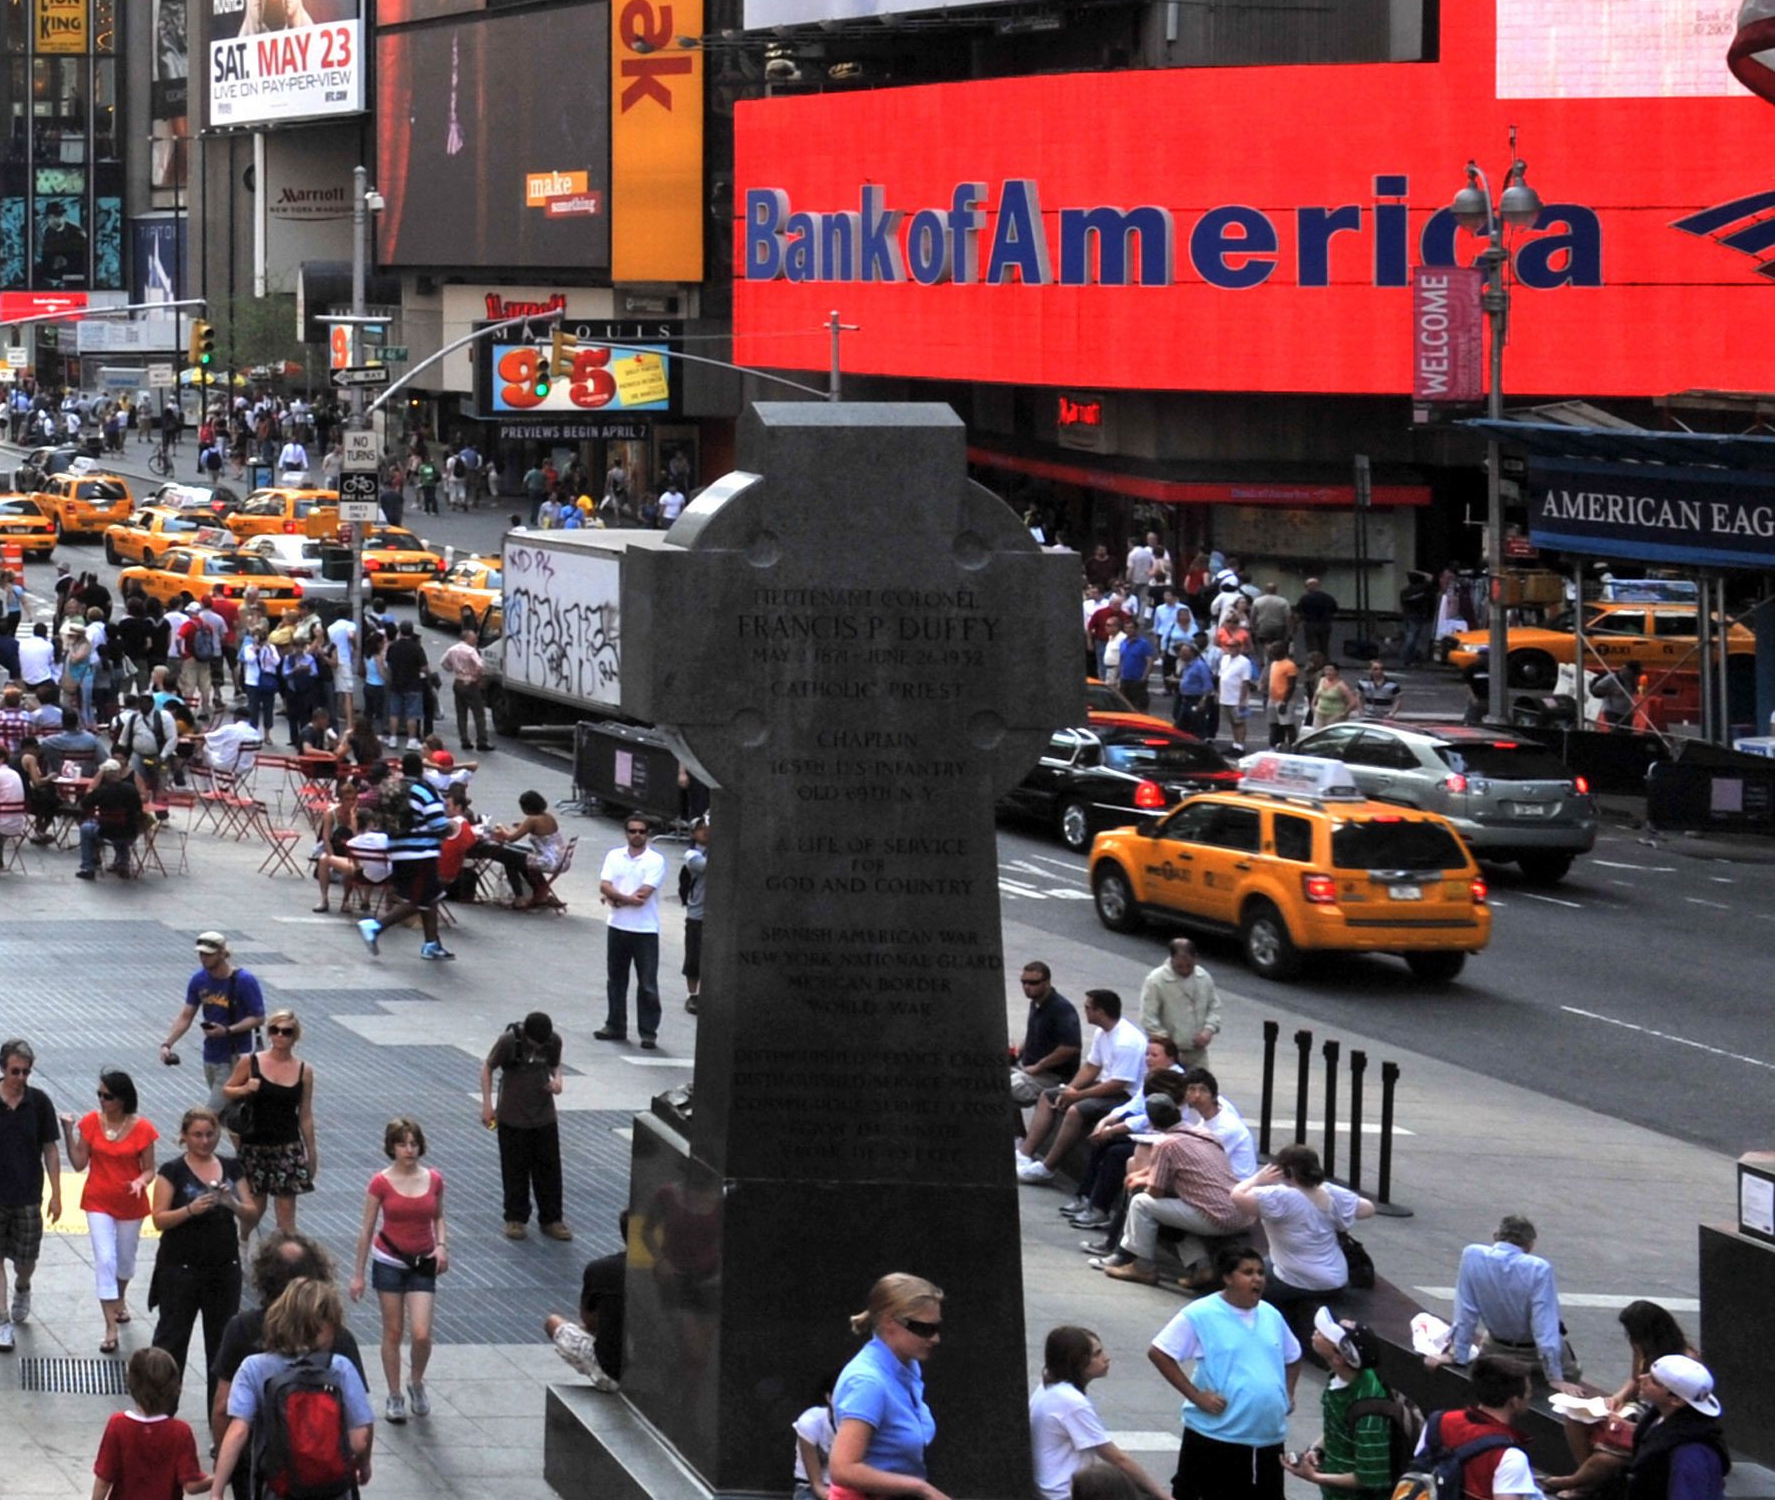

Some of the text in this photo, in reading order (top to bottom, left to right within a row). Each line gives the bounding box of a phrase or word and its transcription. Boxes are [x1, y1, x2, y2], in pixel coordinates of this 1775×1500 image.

[40, 13, 82, 41] KING
[214, 27, 352, 83] SAT. MAY 23
[214, 70, 352, 100] LIVE ON PAY-PER-VIEW
[278, 188, 345, 204] Marriott
[529, 173, 572, 199] make
[551, 194, 597, 214] something
[746, 173, 1604, 290] Bank of America
[1421, 275, 1449, 395] WELCOME
[353, 435, 368, 448] NO
[500, 424, 648, 439] PREVIEWS BEGIN APRIL 7
[346, 450, 376, 462] TURNS
[1541, 488, 1702, 530] AMERICAN
[738, 614, 1001, 643] FRANCIS DUFFY
